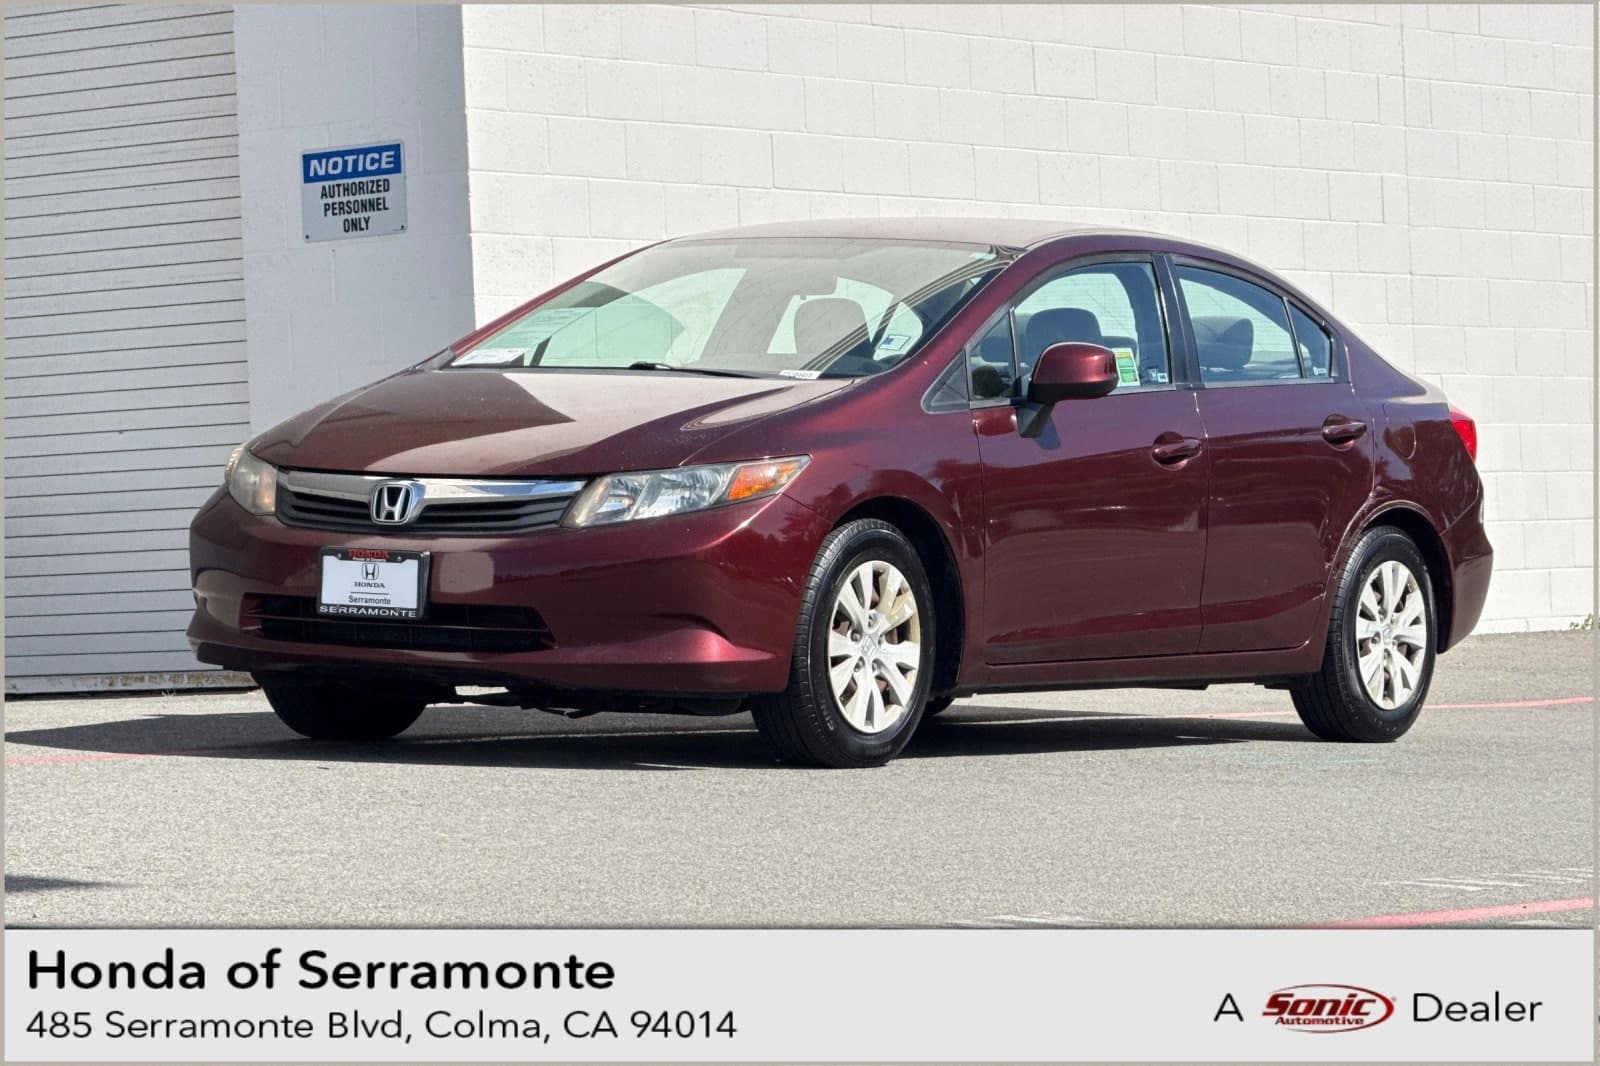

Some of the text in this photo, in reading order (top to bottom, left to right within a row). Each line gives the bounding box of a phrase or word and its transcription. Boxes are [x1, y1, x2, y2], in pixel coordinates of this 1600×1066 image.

[309, 151, 395, 177] NOTICE
[321, 179, 390, 199] AUTHORIZED
[324, 197, 389, 216] PERSONNEL
[343, 216, 370, 233] ONLY
[354, 581, 386, 589] HONDA
[348, 595, 391, 605] Serramonte
[320, 605, 417, 618] SERRAMONTE
